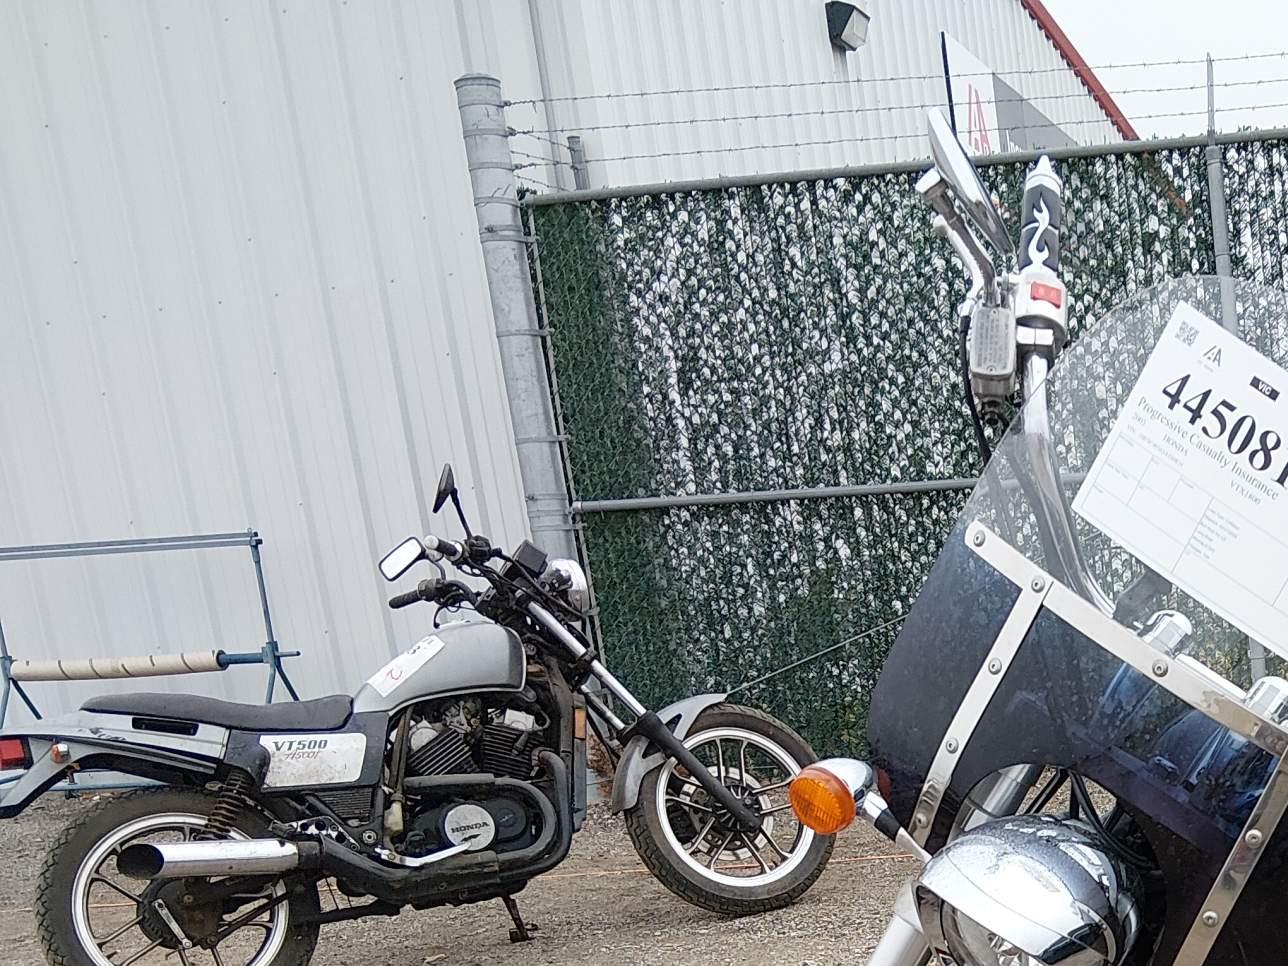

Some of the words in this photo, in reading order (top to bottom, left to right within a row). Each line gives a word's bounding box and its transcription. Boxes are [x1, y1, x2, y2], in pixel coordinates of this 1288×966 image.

[1259, 381, 1272, 396] VIC
[1137, 396, 1189, 439] Progressive
[1189, 432, 1230, 468] Casualty
[1232, 461, 1279, 501] Insurance
[1163, 431, 1189, 456] HONDA
[272, 739, 328, 752] VT500
[451, 821, 489, 834] HONDA
